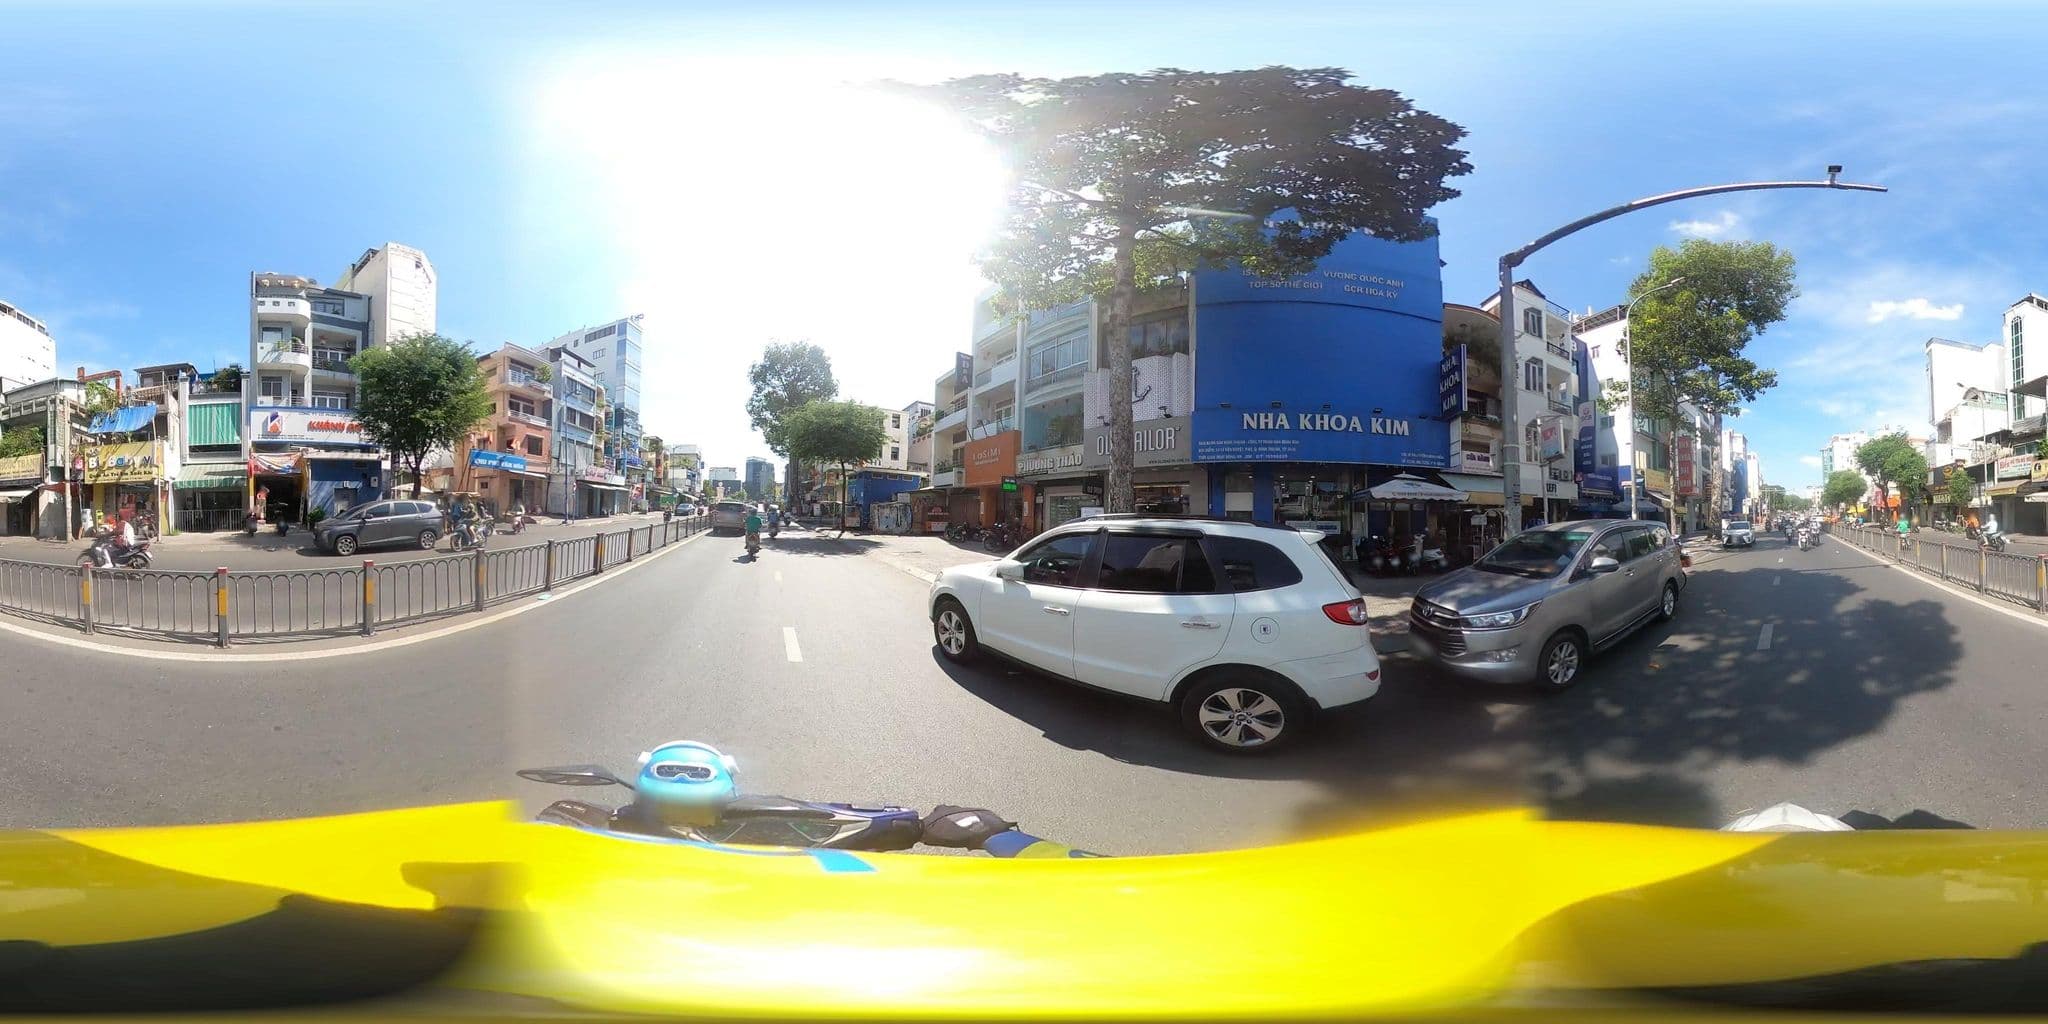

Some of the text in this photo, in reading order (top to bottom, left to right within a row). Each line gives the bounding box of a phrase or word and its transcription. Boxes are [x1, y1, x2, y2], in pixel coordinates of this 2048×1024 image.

[1441, 355, 1456, 375] NHA
[1439, 371, 1461, 394] KHOA
[1442, 394, 1457, 412] KIM
[1243, 412, 1410, 437] NHA KHOA KIM
[1134, 427, 1176, 453] AILOR
